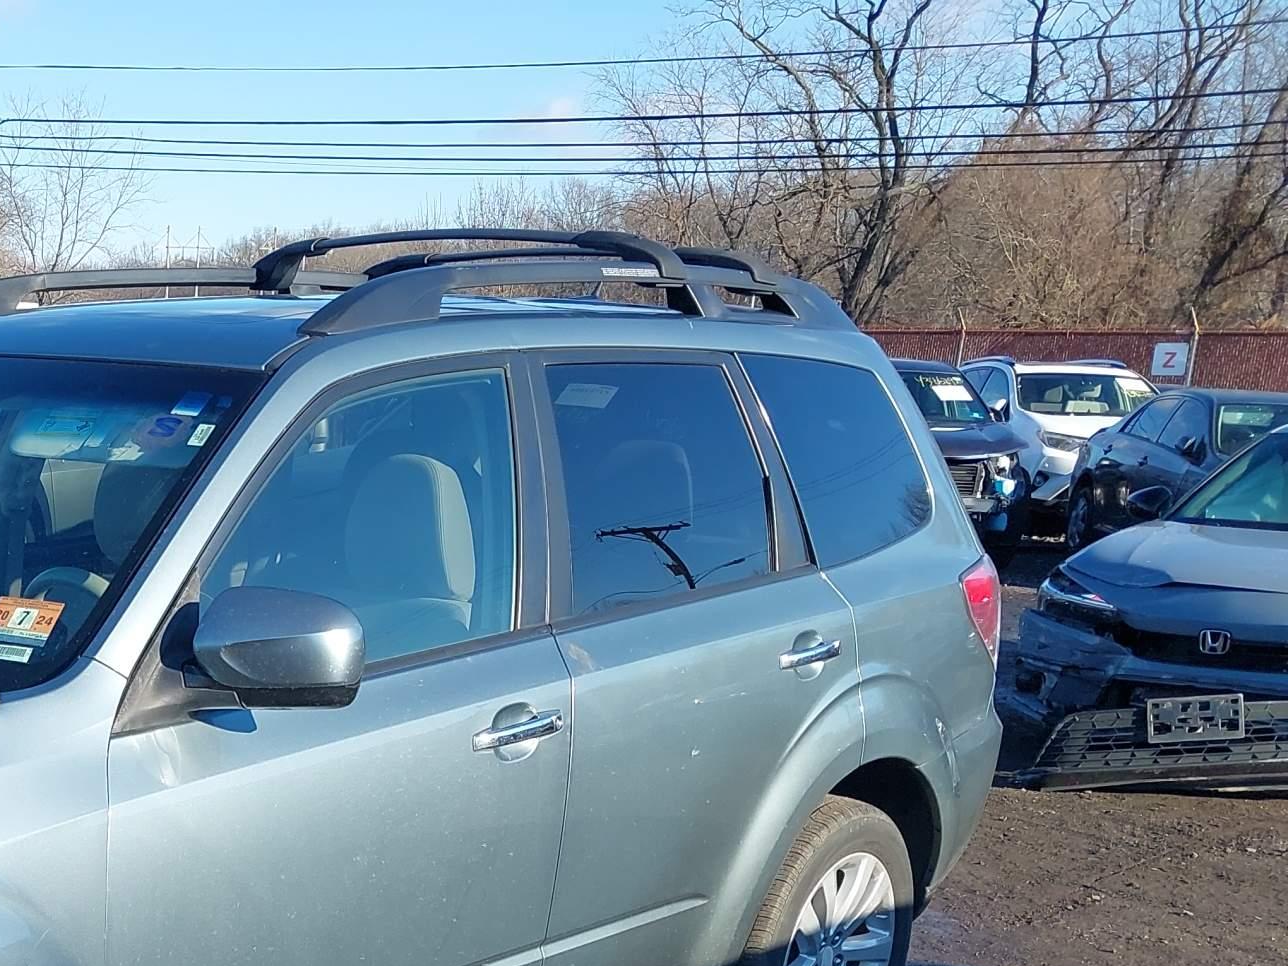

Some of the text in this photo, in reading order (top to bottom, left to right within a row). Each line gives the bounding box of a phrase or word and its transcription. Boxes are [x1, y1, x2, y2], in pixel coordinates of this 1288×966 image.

[1161, 351, 1178, 369] Z
[18, 611, 30, 626] 7
[36, 615, 54, 626] 24
